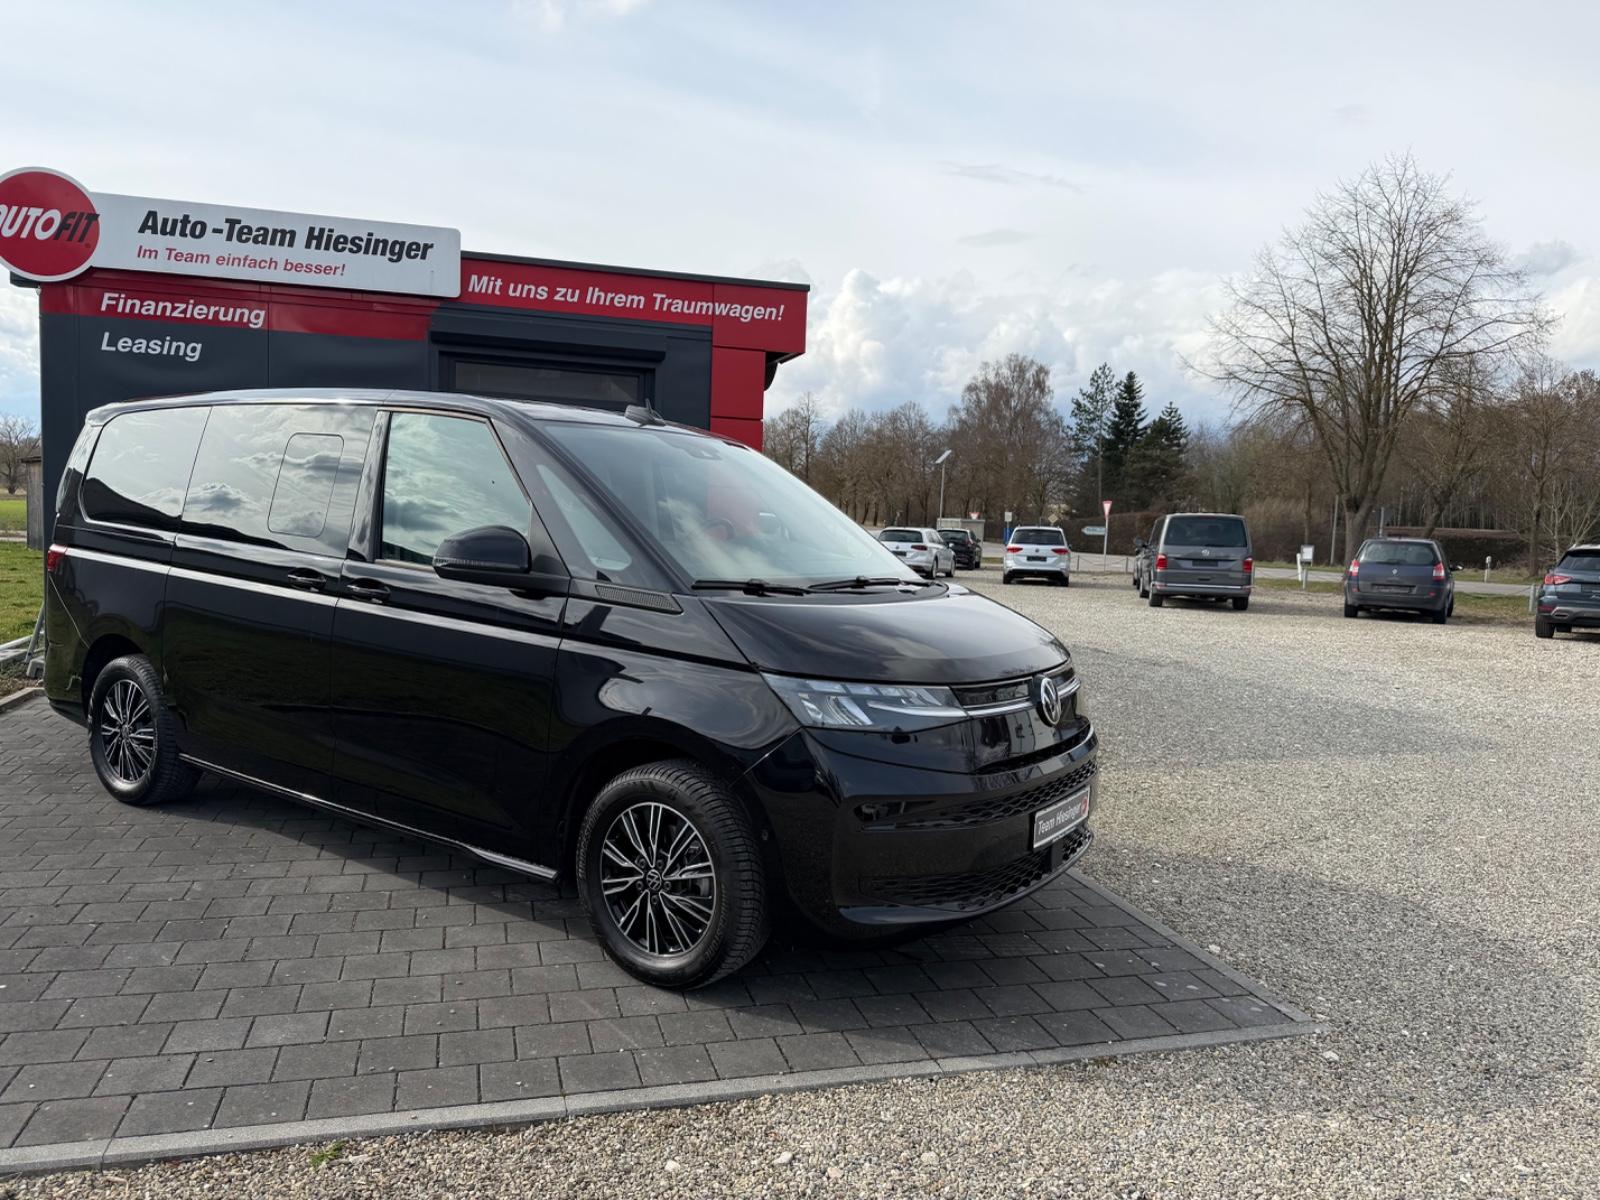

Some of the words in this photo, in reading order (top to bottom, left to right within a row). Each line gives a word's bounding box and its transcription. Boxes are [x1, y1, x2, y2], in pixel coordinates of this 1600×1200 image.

[0, 204, 100, 243] UTOFIT
[138, 210, 207, 239] Auto
[304, 225, 434, 263] Hiesinger
[136, 245, 158, 260] Im
[165, 247, 210, 265] Team
[216, 251, 278, 271] einfach
[283, 258, 346, 276] besser!
[100, 291, 265, 329] Finanzierung
[468, 274, 504, 295] Mit
[508, 282, 548, 300] uns
[554, 287, 580, 303] zu
[585, 286, 645, 310] Ihrem
[652, 293, 784, 323] Traumwagen!
[101, 331, 203, 362] Leasing
[1038, 817, 1056, 836] Team
